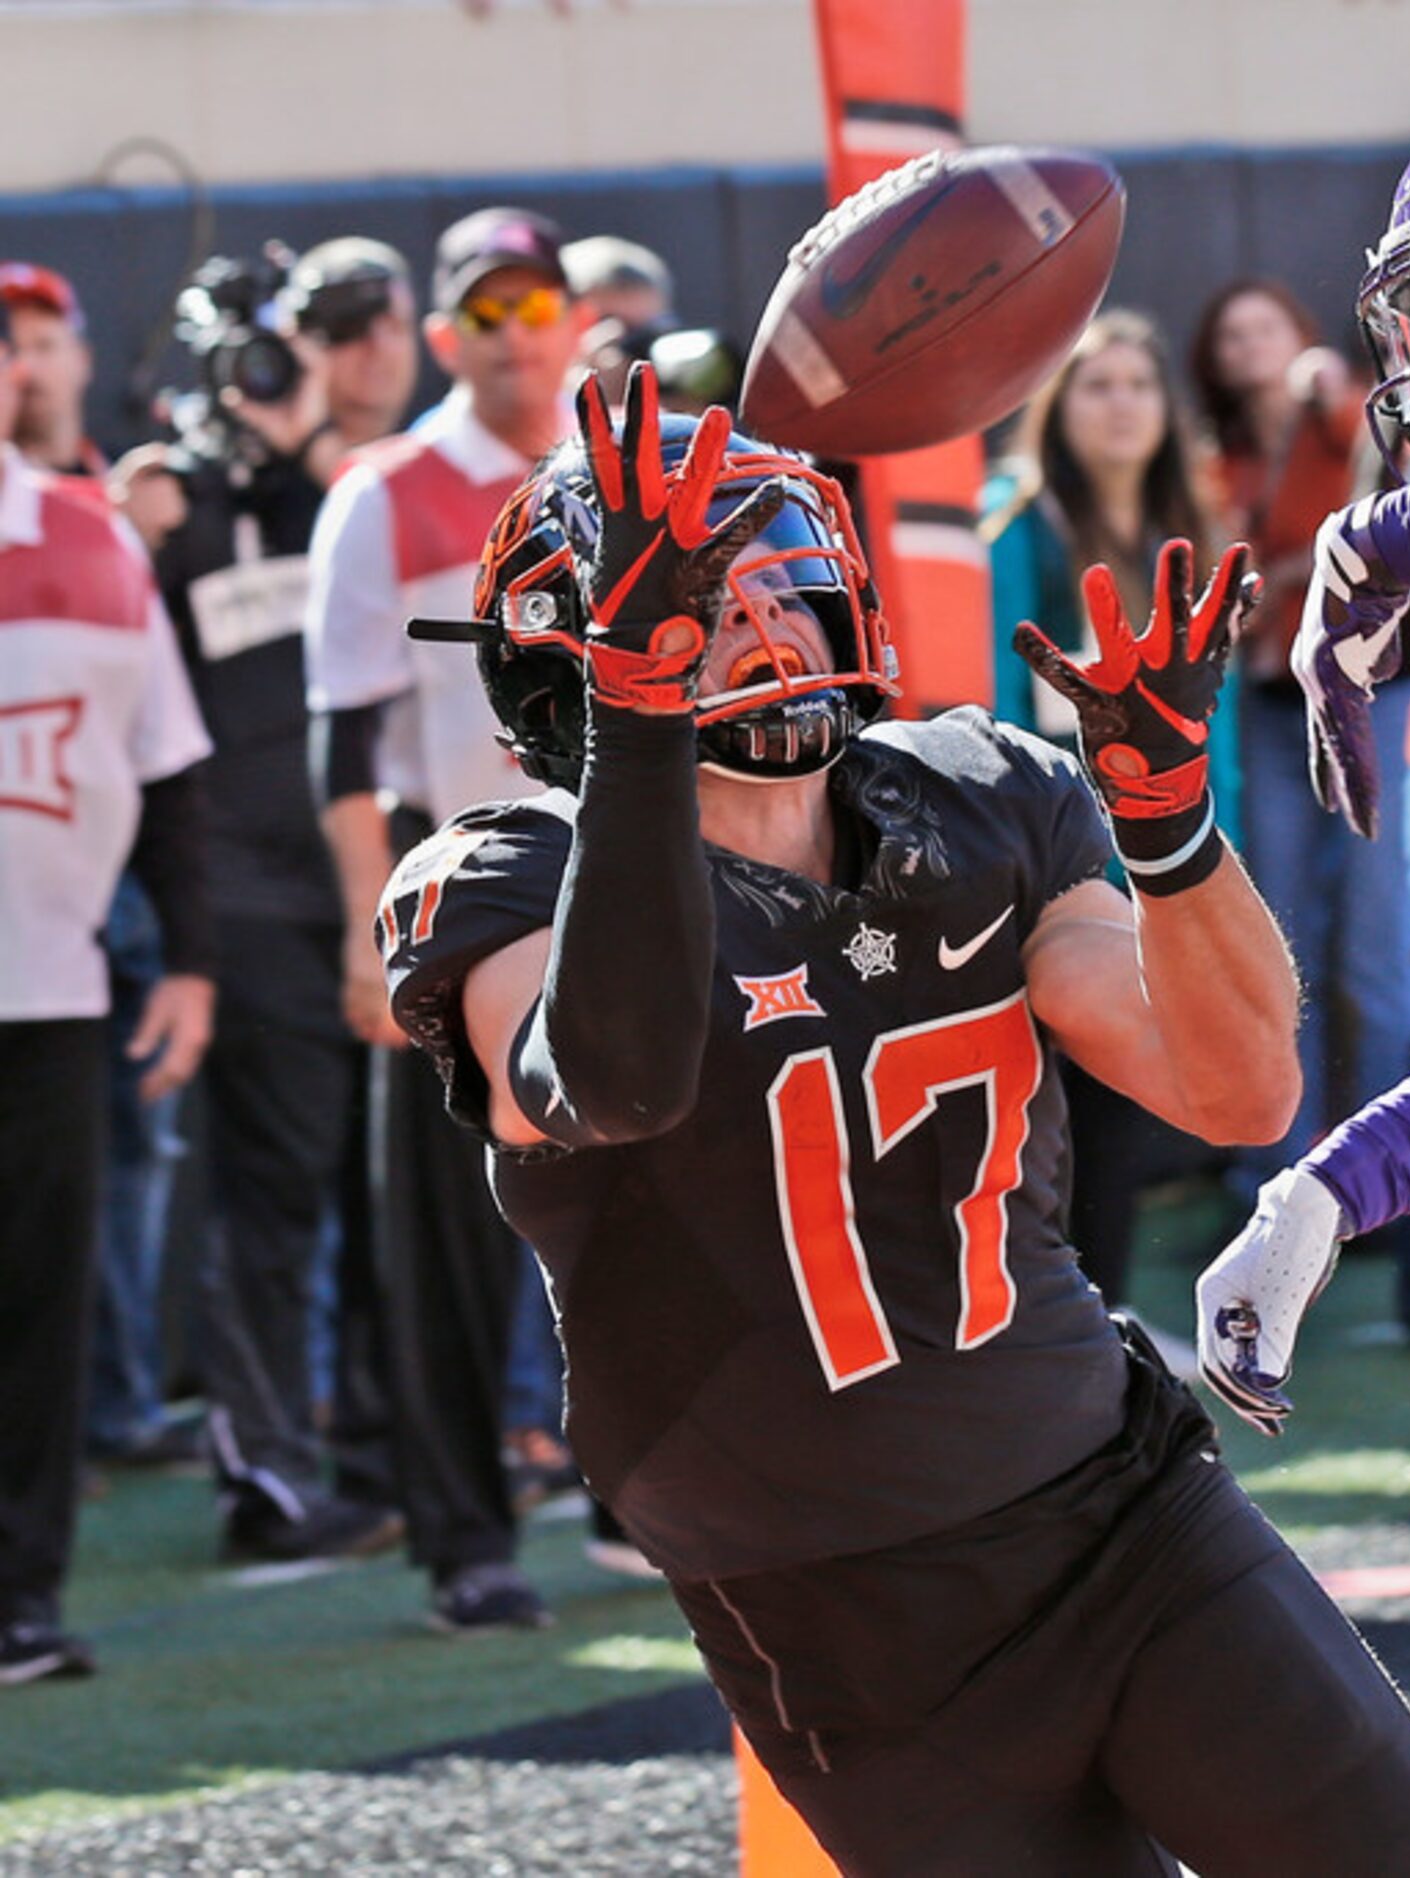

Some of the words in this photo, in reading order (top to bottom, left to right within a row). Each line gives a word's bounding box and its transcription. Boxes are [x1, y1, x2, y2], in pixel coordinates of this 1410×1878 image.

[0, 697, 84, 824] II
[737, 965, 823, 1028] XII
[766, 986, 1044, 1393] 17
